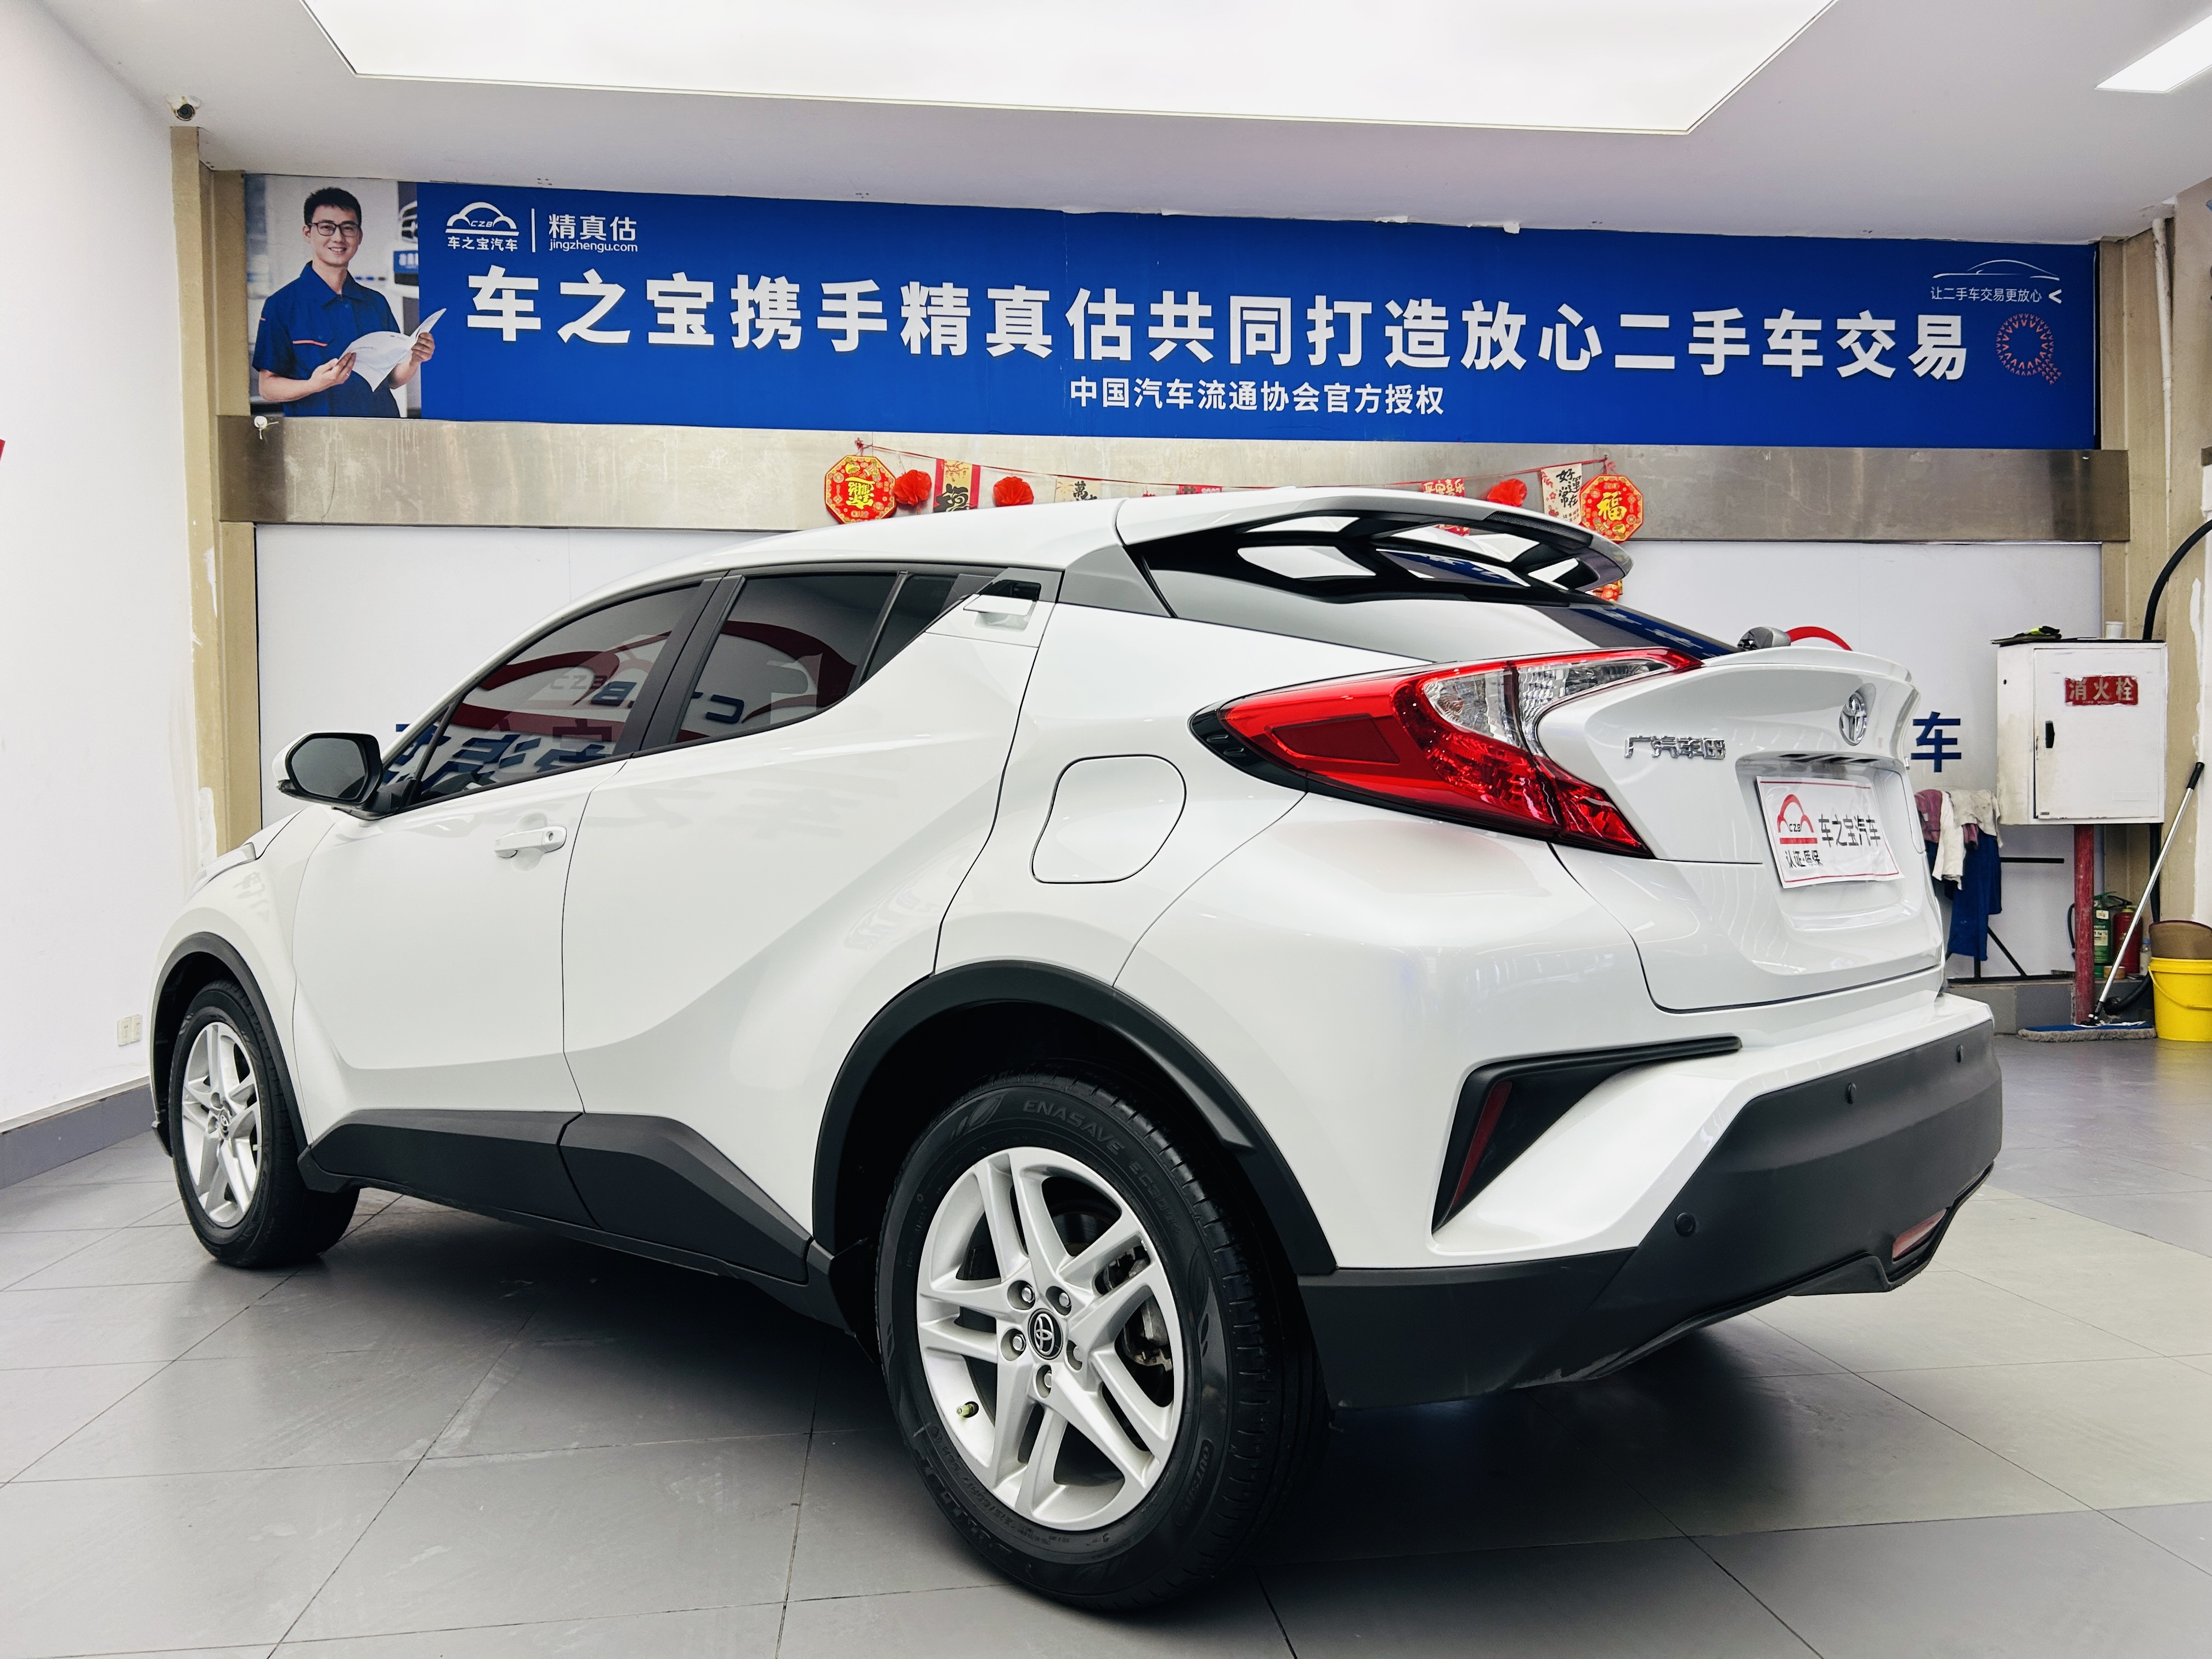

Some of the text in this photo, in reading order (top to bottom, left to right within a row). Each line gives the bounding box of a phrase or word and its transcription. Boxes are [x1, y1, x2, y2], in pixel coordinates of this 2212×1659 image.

[549, 213, 637, 241] 精真估
[447, 236, 518, 252] 车之宝汽车
[549, 239, 639, 253] jingzhengu.com
[1930, 286, 2042, 303] 让二手车交易更放心
[467, 264, 1967, 381] 车之宝携手精真估共同打造放心二手车交易
[1069, 376, 1444, 415] 中国汽车流通协会官方授权
[1596, 491, 1627, 521] 福
[2067, 676, 2134, 701] 消火栓
[1911, 712, 1962, 773] 车
[1818, 814, 1881, 848] 车之宝汽车
[1022, 1098, 1126, 1156] ENASAVE
